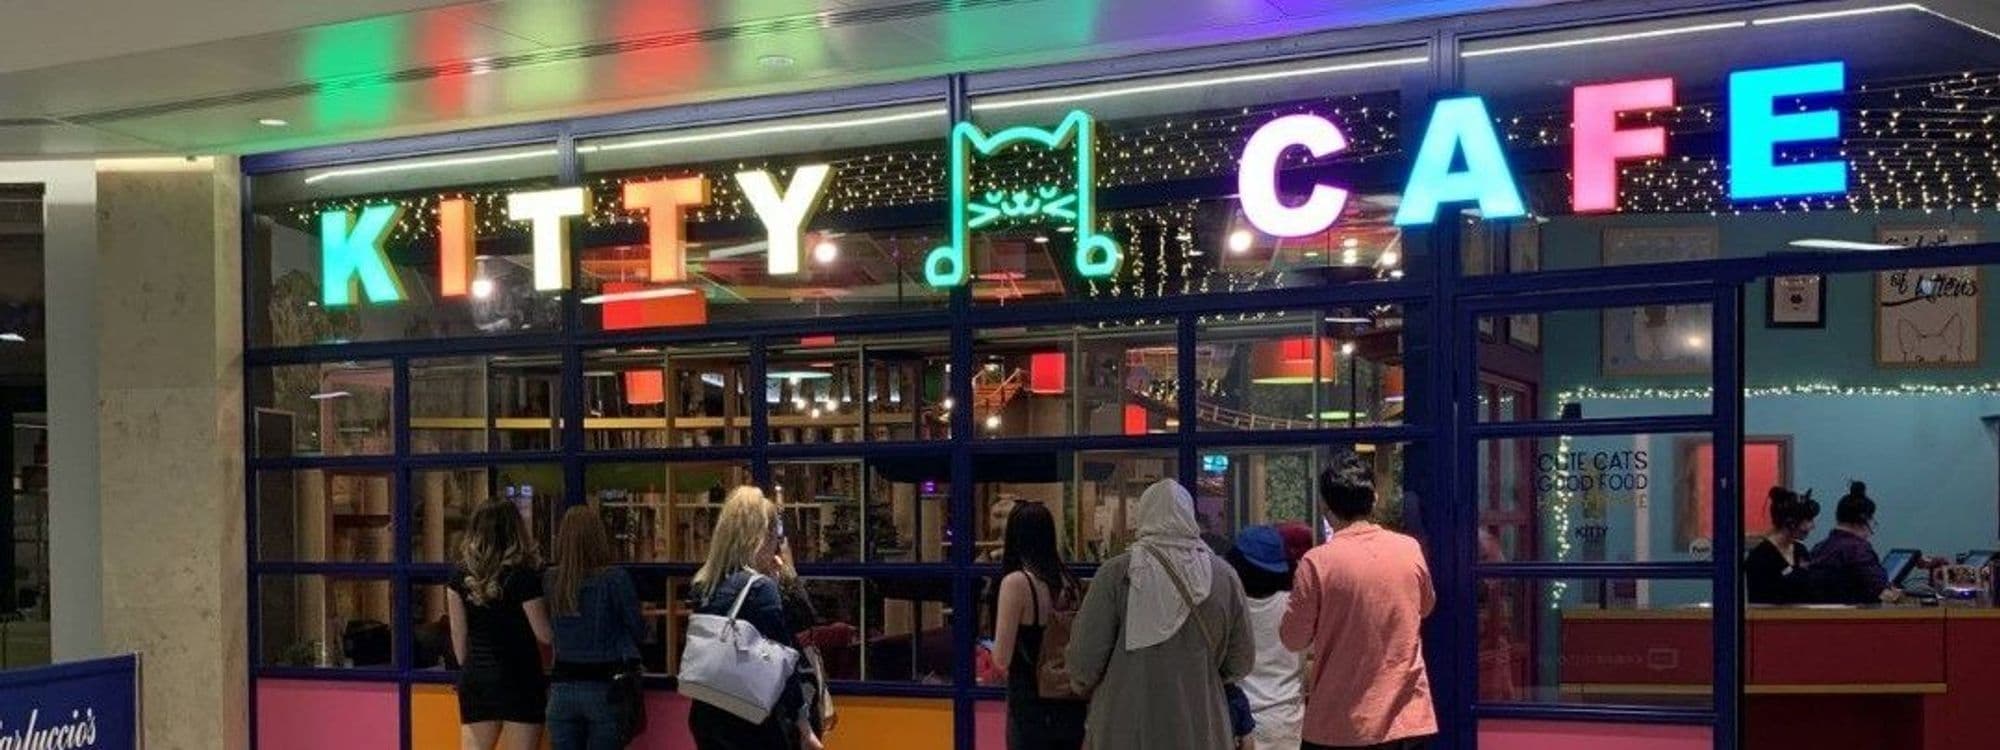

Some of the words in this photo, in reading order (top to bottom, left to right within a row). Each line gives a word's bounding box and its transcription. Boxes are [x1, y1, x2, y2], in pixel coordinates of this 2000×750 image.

[320, 164, 831, 306] KITTY
[1237, 61, 1847, 238] CAFE
[1594, 451, 1647, 470] CATS
[1539, 475, 1594, 492] GOOD
[1599, 474, 1647, 491] FOOD
[0, 707, 97, 750] arluccio's
